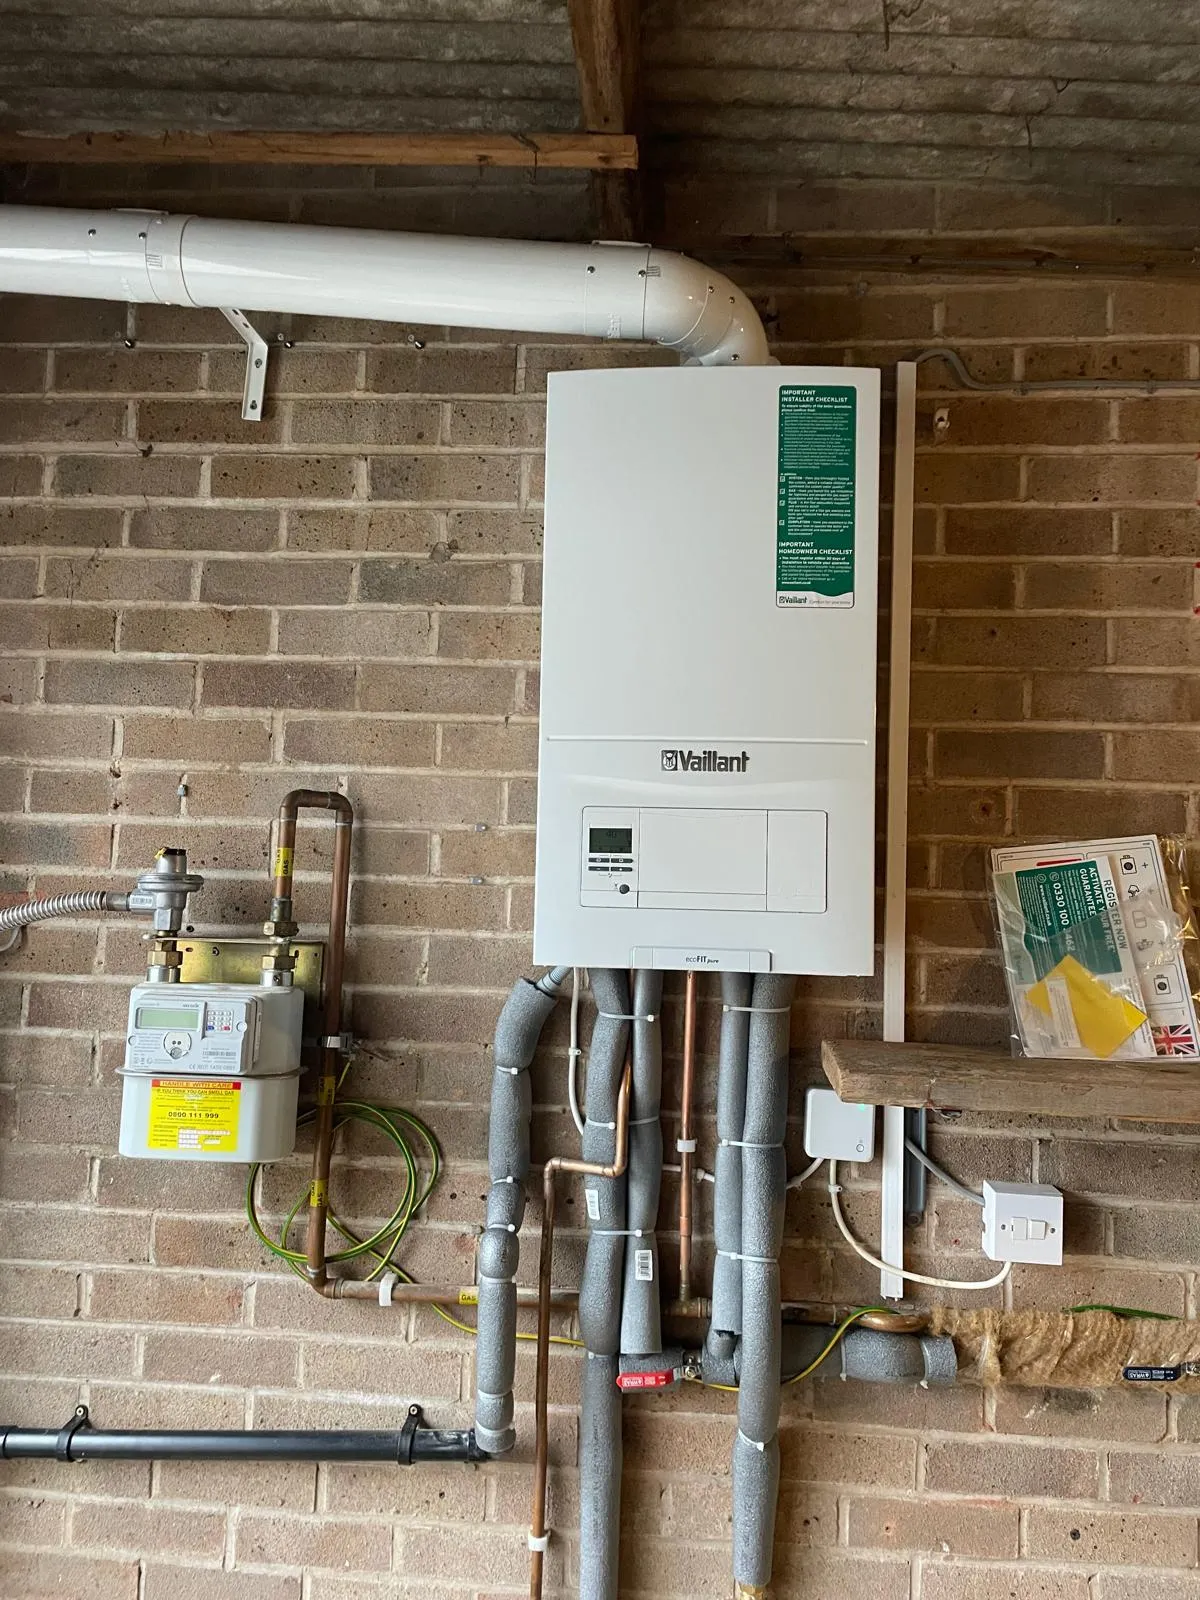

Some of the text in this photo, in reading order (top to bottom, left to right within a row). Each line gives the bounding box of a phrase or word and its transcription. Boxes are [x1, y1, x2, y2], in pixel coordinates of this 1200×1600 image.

[783, 596, 807, 604] Vaillant
[679, 750, 750, 772] Vaillant
[1052, 882, 1066, 908] 0330
[1079, 868, 1097, 916] GUARANTEE
[1088, 867, 1104, 904] ACTIVATE
[1058, 909, 1070, 926] 100
[1103, 879, 1128, 950] REGISTER NOW
[461, 1294, 477, 1302] GAS
